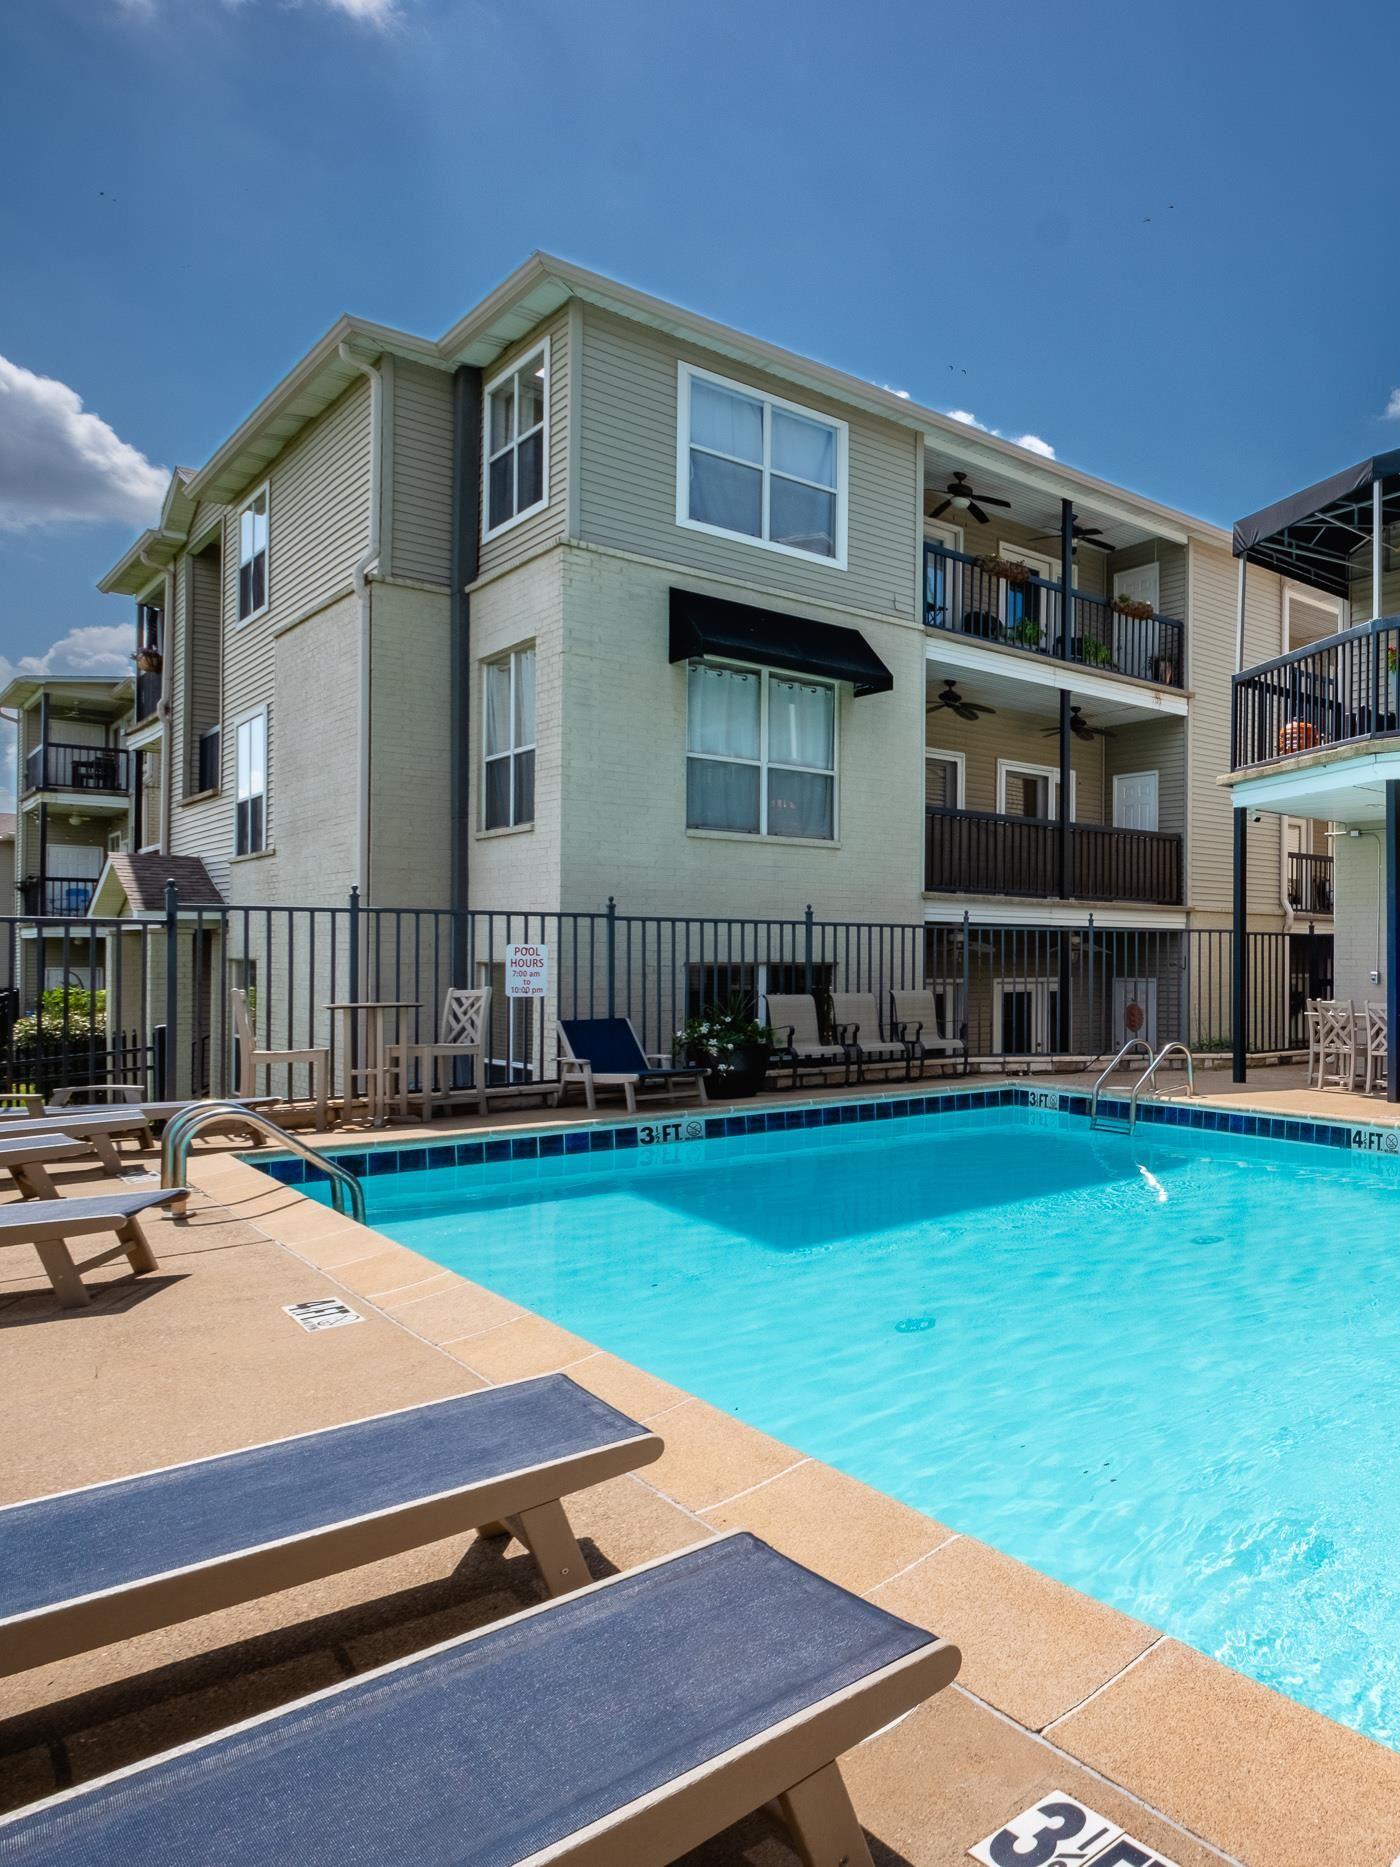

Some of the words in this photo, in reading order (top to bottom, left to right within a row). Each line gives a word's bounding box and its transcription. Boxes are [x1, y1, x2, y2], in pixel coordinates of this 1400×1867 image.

[514, 947, 541, 957] POOL
[510, 958, 544, 968] HOURS
[511, 986, 531, 994] 10:00
[532, 987, 543, 995] pm
